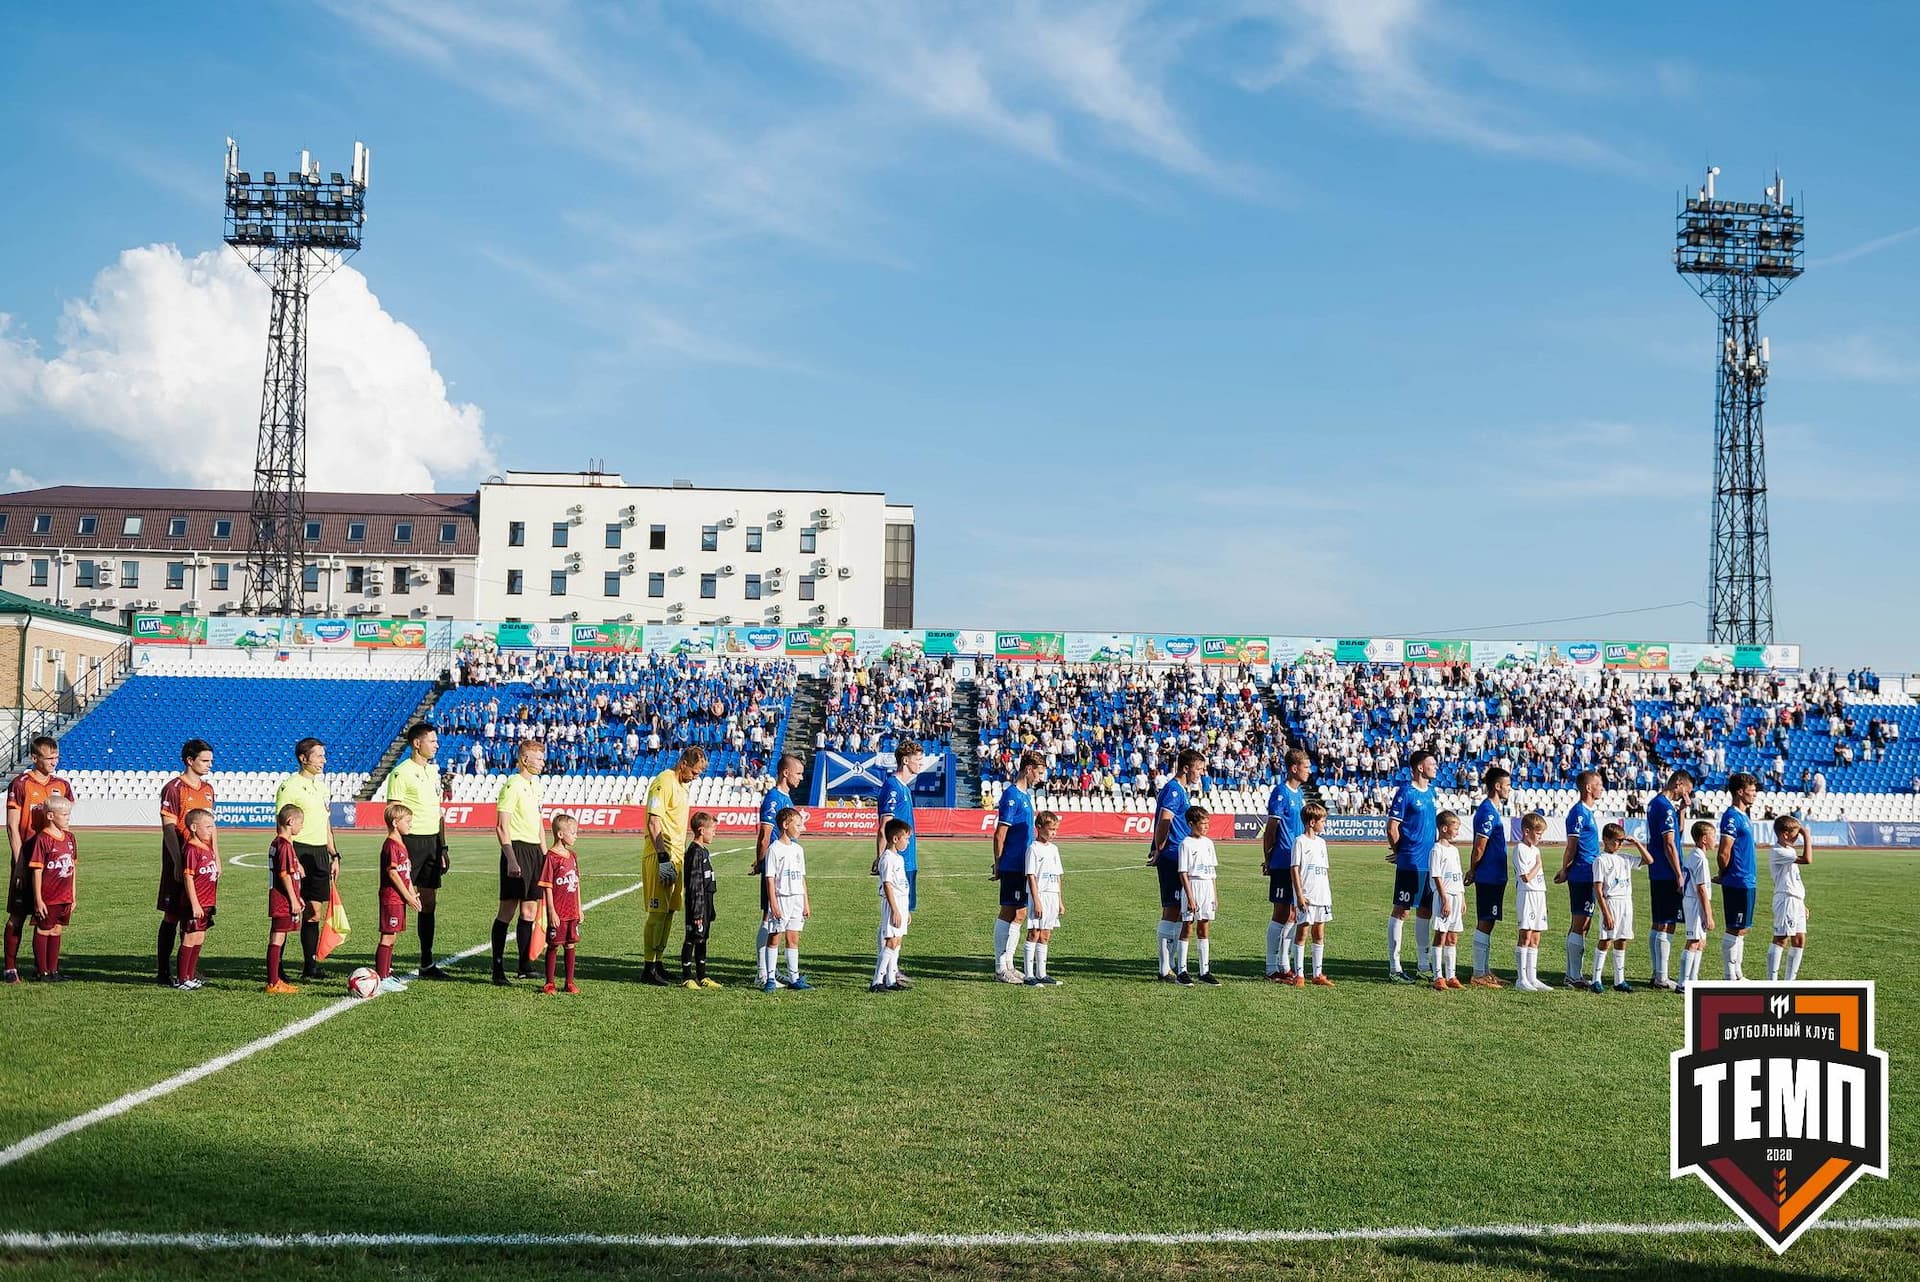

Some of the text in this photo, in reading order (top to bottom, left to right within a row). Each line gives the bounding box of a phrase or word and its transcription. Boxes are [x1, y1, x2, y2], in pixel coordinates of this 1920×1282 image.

[214, 805, 276, 814] ДМИНИСТРА
[854, 812, 879, 820] РОСС
[1123, 816, 1155, 834] FO
[1323, 820, 1386, 828] ВИТЕЛЬСТВО
[1367, 828, 1388, 837] КРА
[1399, 891, 1410, 902] 30
[1492, 905, 1498, 916] 8
